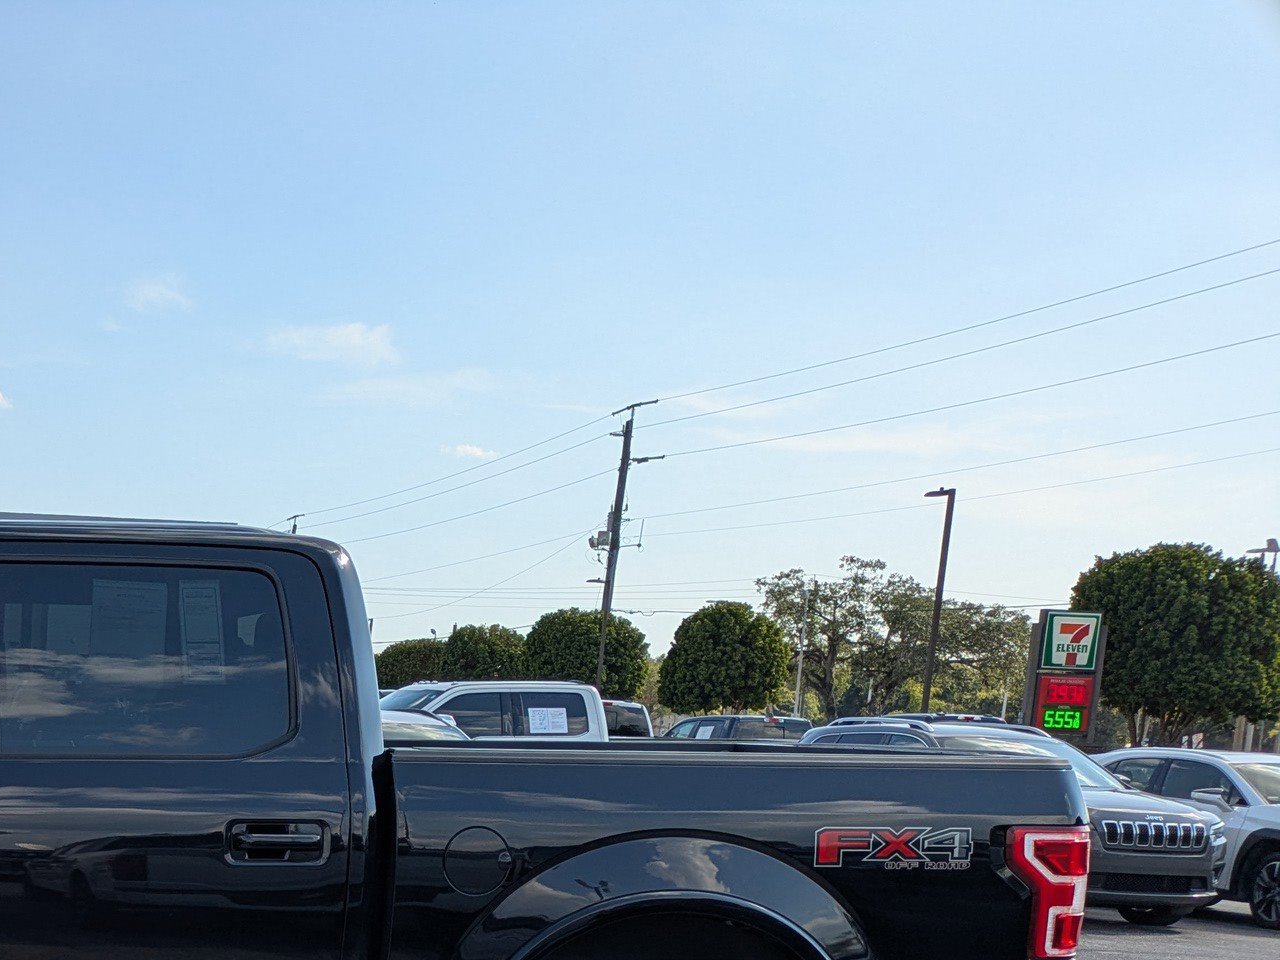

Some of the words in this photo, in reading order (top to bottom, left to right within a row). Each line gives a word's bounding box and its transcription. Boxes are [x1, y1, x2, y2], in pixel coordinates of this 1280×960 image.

[1060, 623, 1091, 666] 7
[1144, 814, 1164, 822] Jeep
[814, 826, 973, 868] FX4
[884, 861, 919, 870] OFF
[924, 861, 971, 870] ROAD
